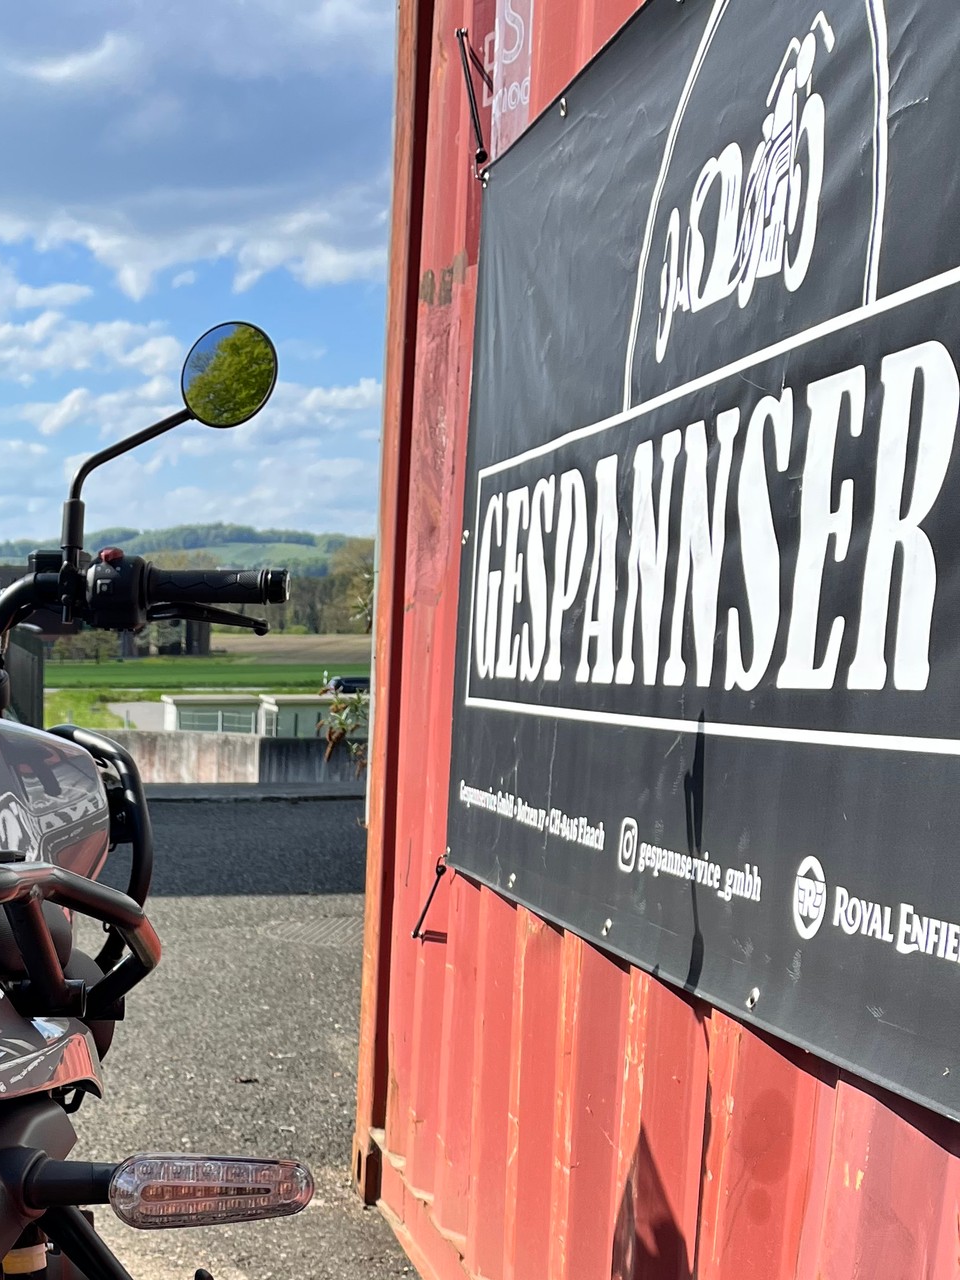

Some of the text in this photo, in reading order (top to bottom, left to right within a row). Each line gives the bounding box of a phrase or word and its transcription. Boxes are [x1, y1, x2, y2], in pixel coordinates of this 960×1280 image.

[476, 340, 960, 692] GESPANNSER
[497, 790, 515, 818] GmbH
[578, 816, 605, 851] Flaach
[638, 841, 762, 902] gespannservice_gmbh
[832, 886, 960, 964] ROYAL ENFIE
